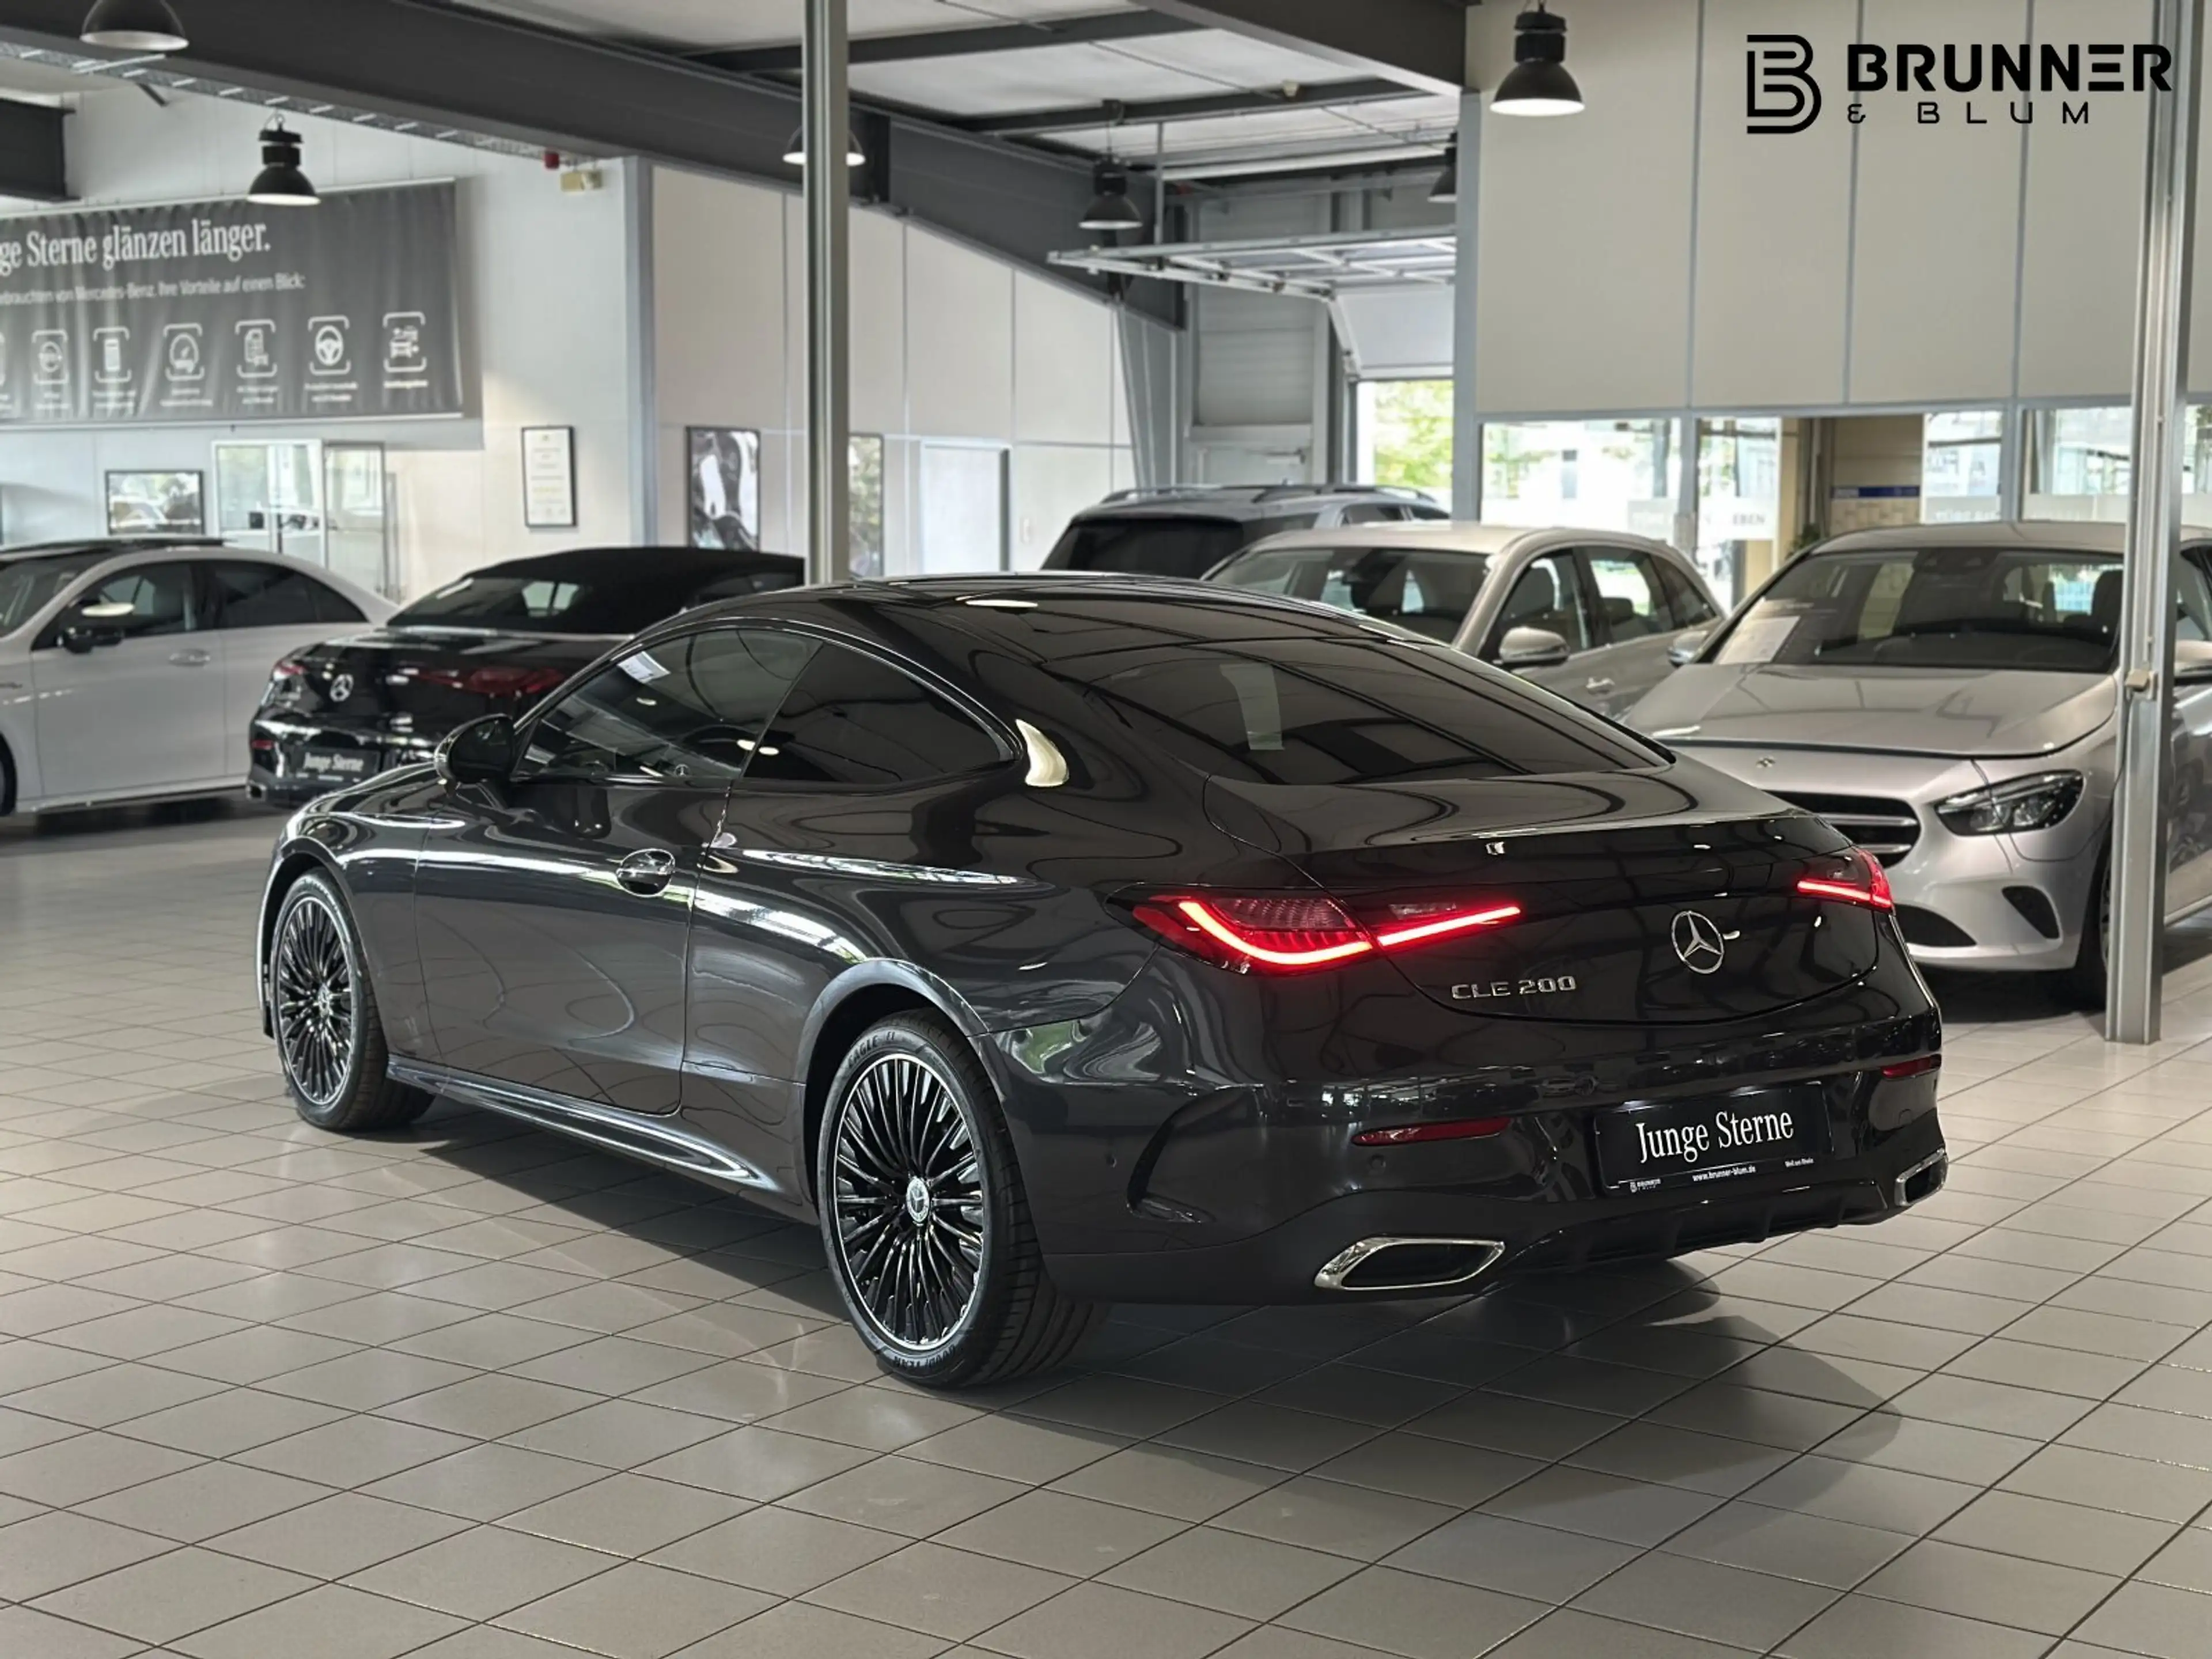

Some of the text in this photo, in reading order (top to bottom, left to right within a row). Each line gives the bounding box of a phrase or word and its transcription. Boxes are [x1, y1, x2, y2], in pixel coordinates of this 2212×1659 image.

[26, 230, 97, 267] Sterne
[102, 225, 188, 271] glänzen
[191, 217, 271, 262] länger.
[223, 274, 241, 294] auf
[242, 276, 274, 293] einen
[332, 753, 365, 772] Sterne
[1450, 975, 1577, 1000] CLE 200
[1635, 1111, 1794, 1162] Junge Sterne
[1692, 1165, 1756, 1181] www.brunner-blum.de
